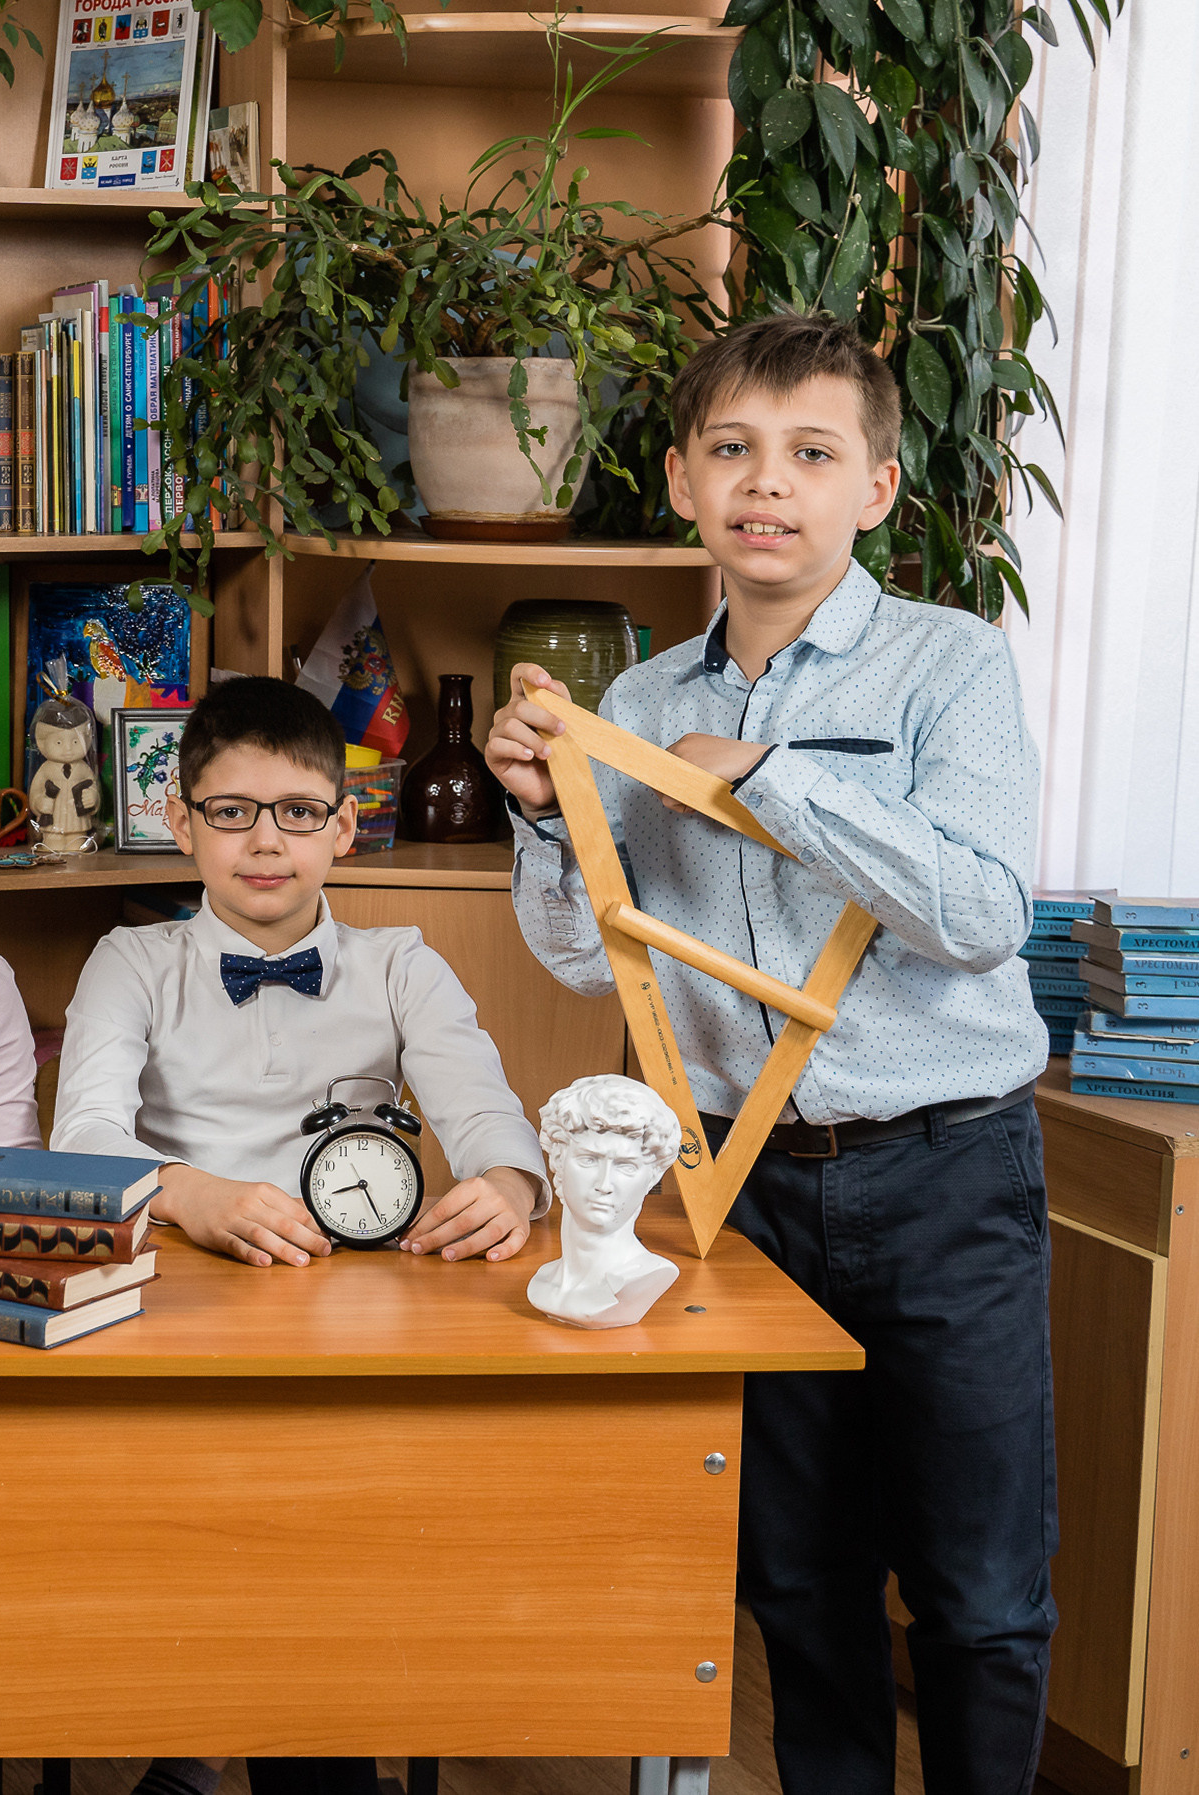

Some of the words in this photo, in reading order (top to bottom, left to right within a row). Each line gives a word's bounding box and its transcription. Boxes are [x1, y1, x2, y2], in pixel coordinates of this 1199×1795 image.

[150, 391, 158, 420] ОБРАЯ
[125, 414, 133, 438] ДЕТЯМ
[175, 474, 183, 513] ПЕРВО
[1026, 942, 1089, 954] СТОМАТИЯ
[1133, 938, 1199, 950] ХРЕСТОМАТ
[1181, 980, 1199, 988] АСТЬ
[1137, 1002, 1149, 1010] 3
[1175, 1025, 1199, 1034] АСТЬ
[1085, 1061, 1097, 1069] 3
[1085, 1083, 1179, 1099] ХРЕСТОМАТИЯ.
[357, 1140, 368, 1150] 12
[380, 1145, 385, 1156] 1
[339, 1146, 348, 1157] 11
[325, 1160, 335, 1171] 10
[394, 1159, 401, 1170] 2
[317, 1179, 325, 1190] 9
[401, 1179, 408, 1190] 3
[324, 1199, 332, 1209] 8
[393, 1199, 401, 1209] 4
[339, 1213, 347, 1224] 7
[358, 1218, 366, 1230] 6
[380, 1214, 387, 1225] 5
